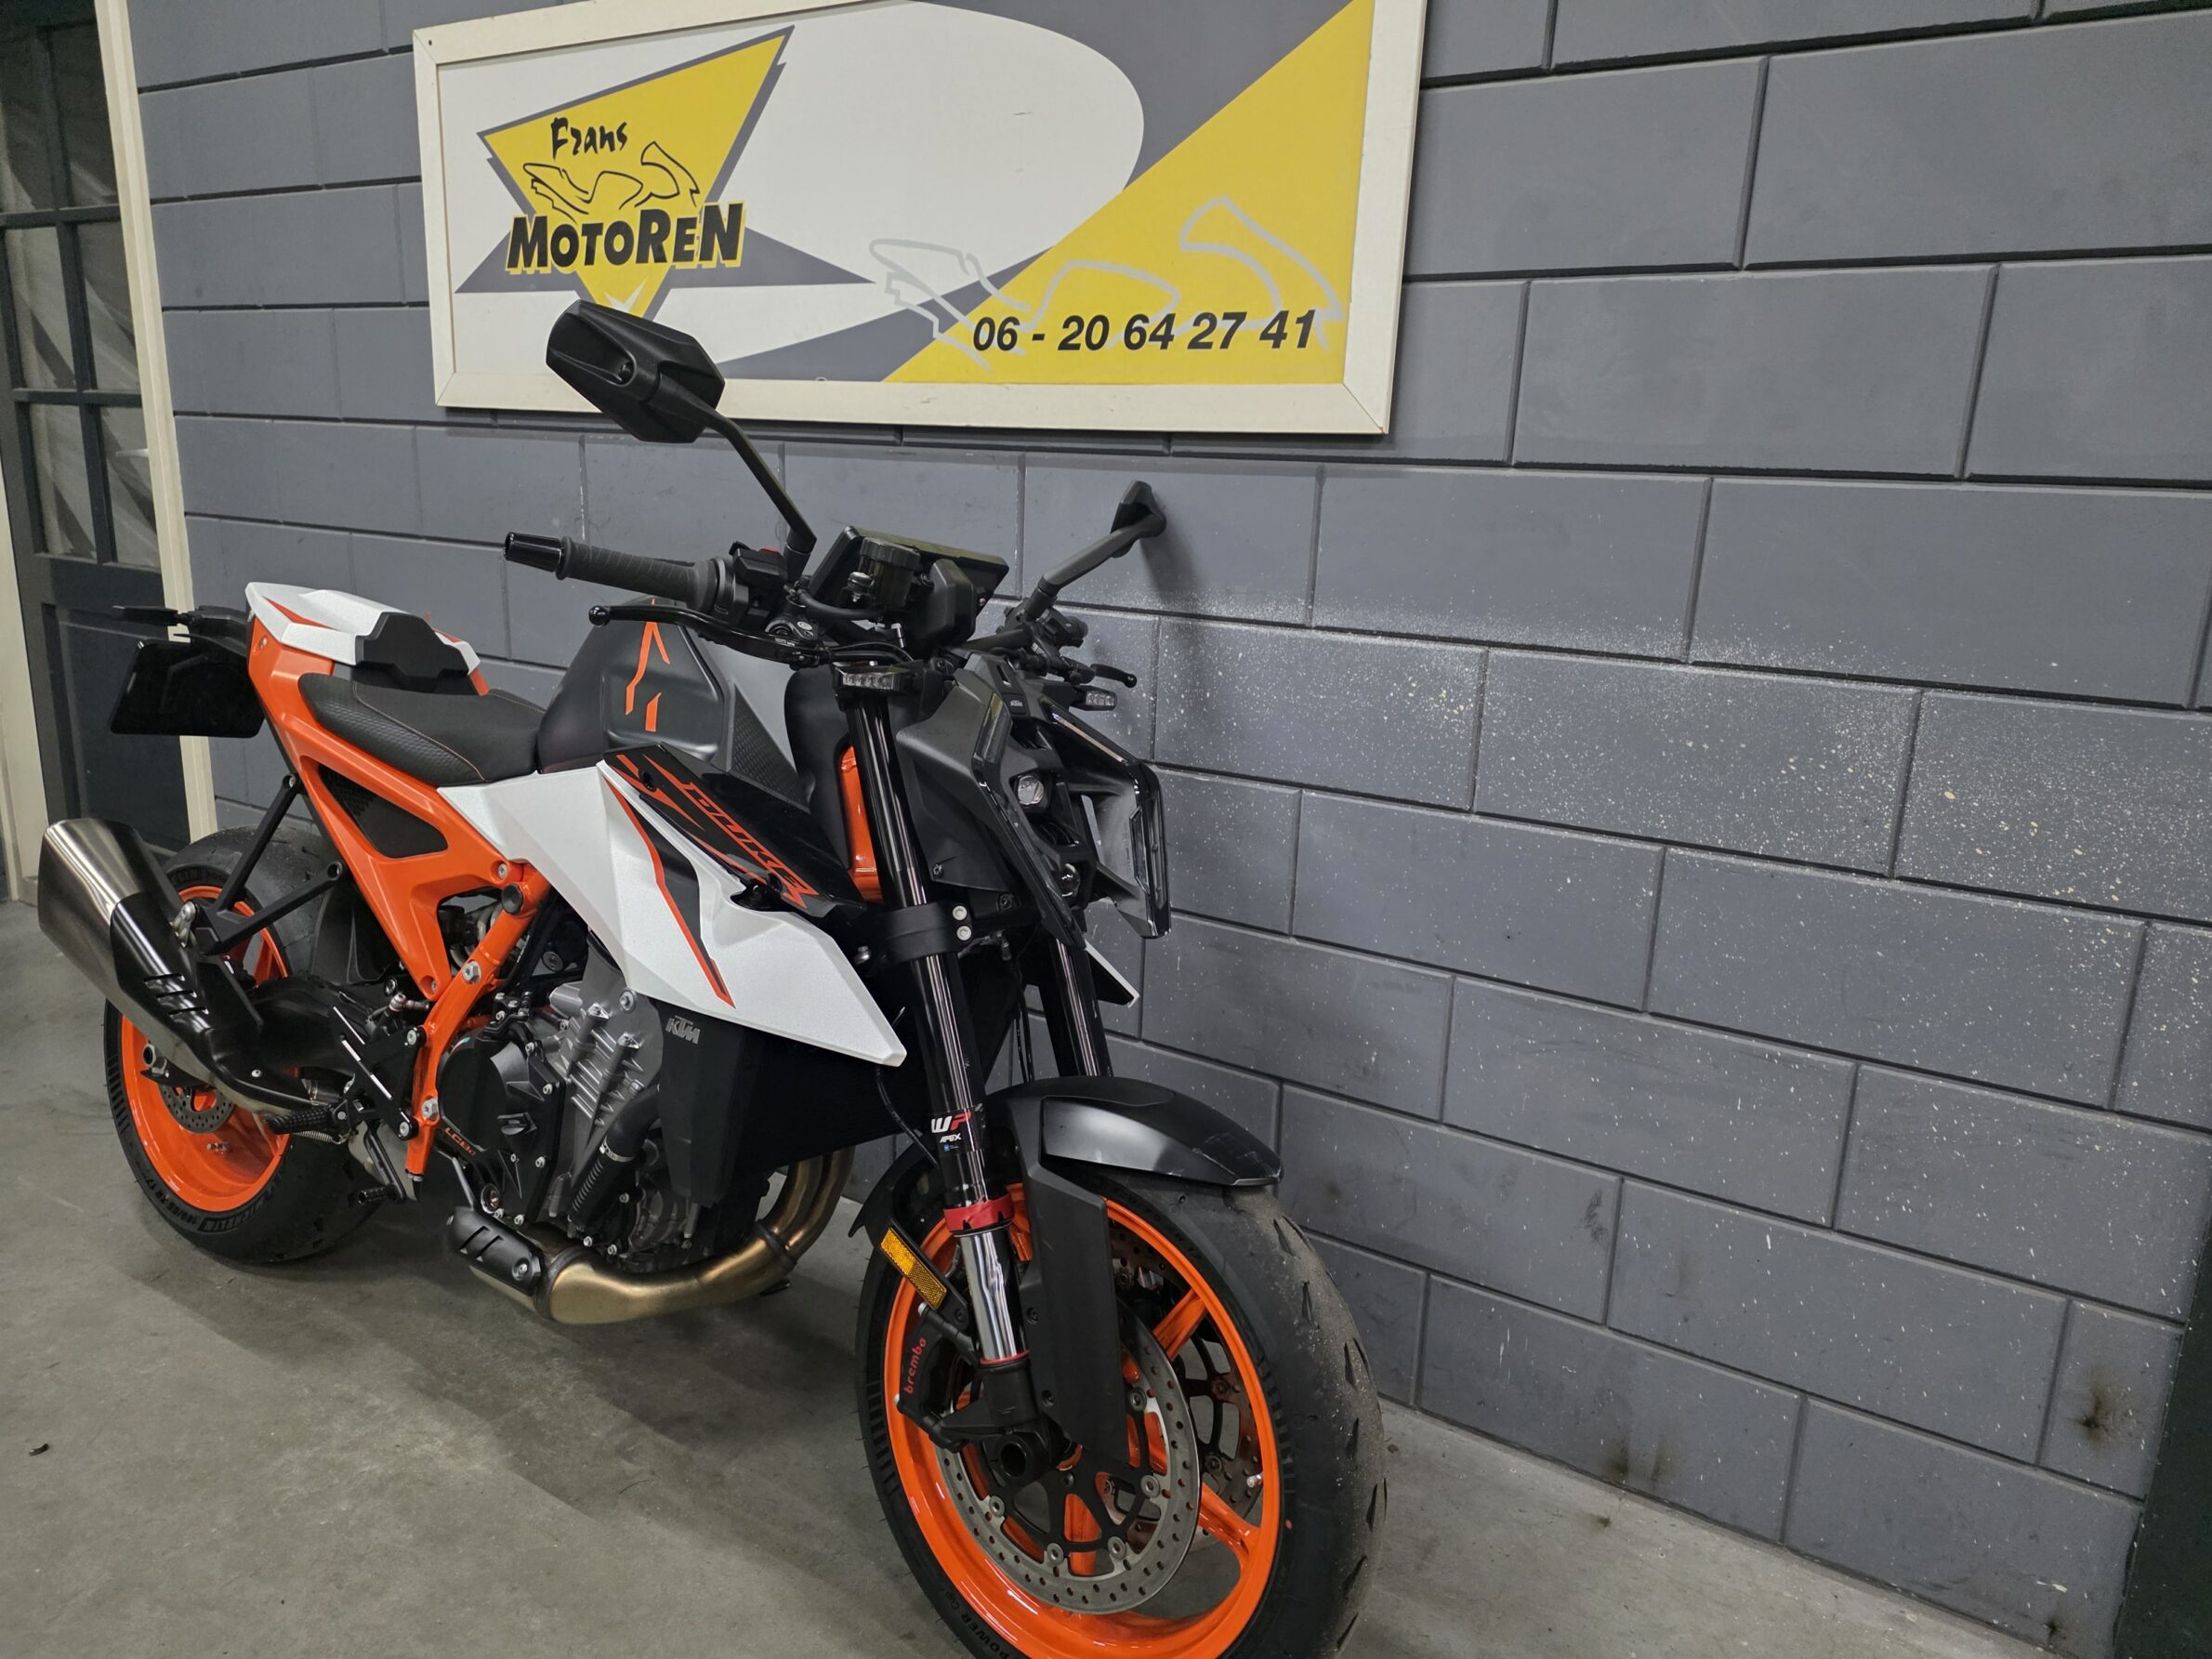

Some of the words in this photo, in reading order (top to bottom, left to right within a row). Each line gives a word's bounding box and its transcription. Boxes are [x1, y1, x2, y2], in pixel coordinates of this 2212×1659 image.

[551, 117, 628, 159] Frans
[972, 316, 1018, 351] 06
[1032, 331, 1046, 341] -
[1058, 314, 1110, 351] 20
[1123, 312, 1175, 350] 64
[1187, 311, 1247, 349] 27
[1259, 309, 1316, 349] 41
[665, 1015, 701, 1045] KTM
[930, 1112, 971, 1133] WP
[940, 1133, 962, 1143] APEX
[903, 1337, 927, 1394] brembo
[960, 1612, 1010, 1659] POWER
